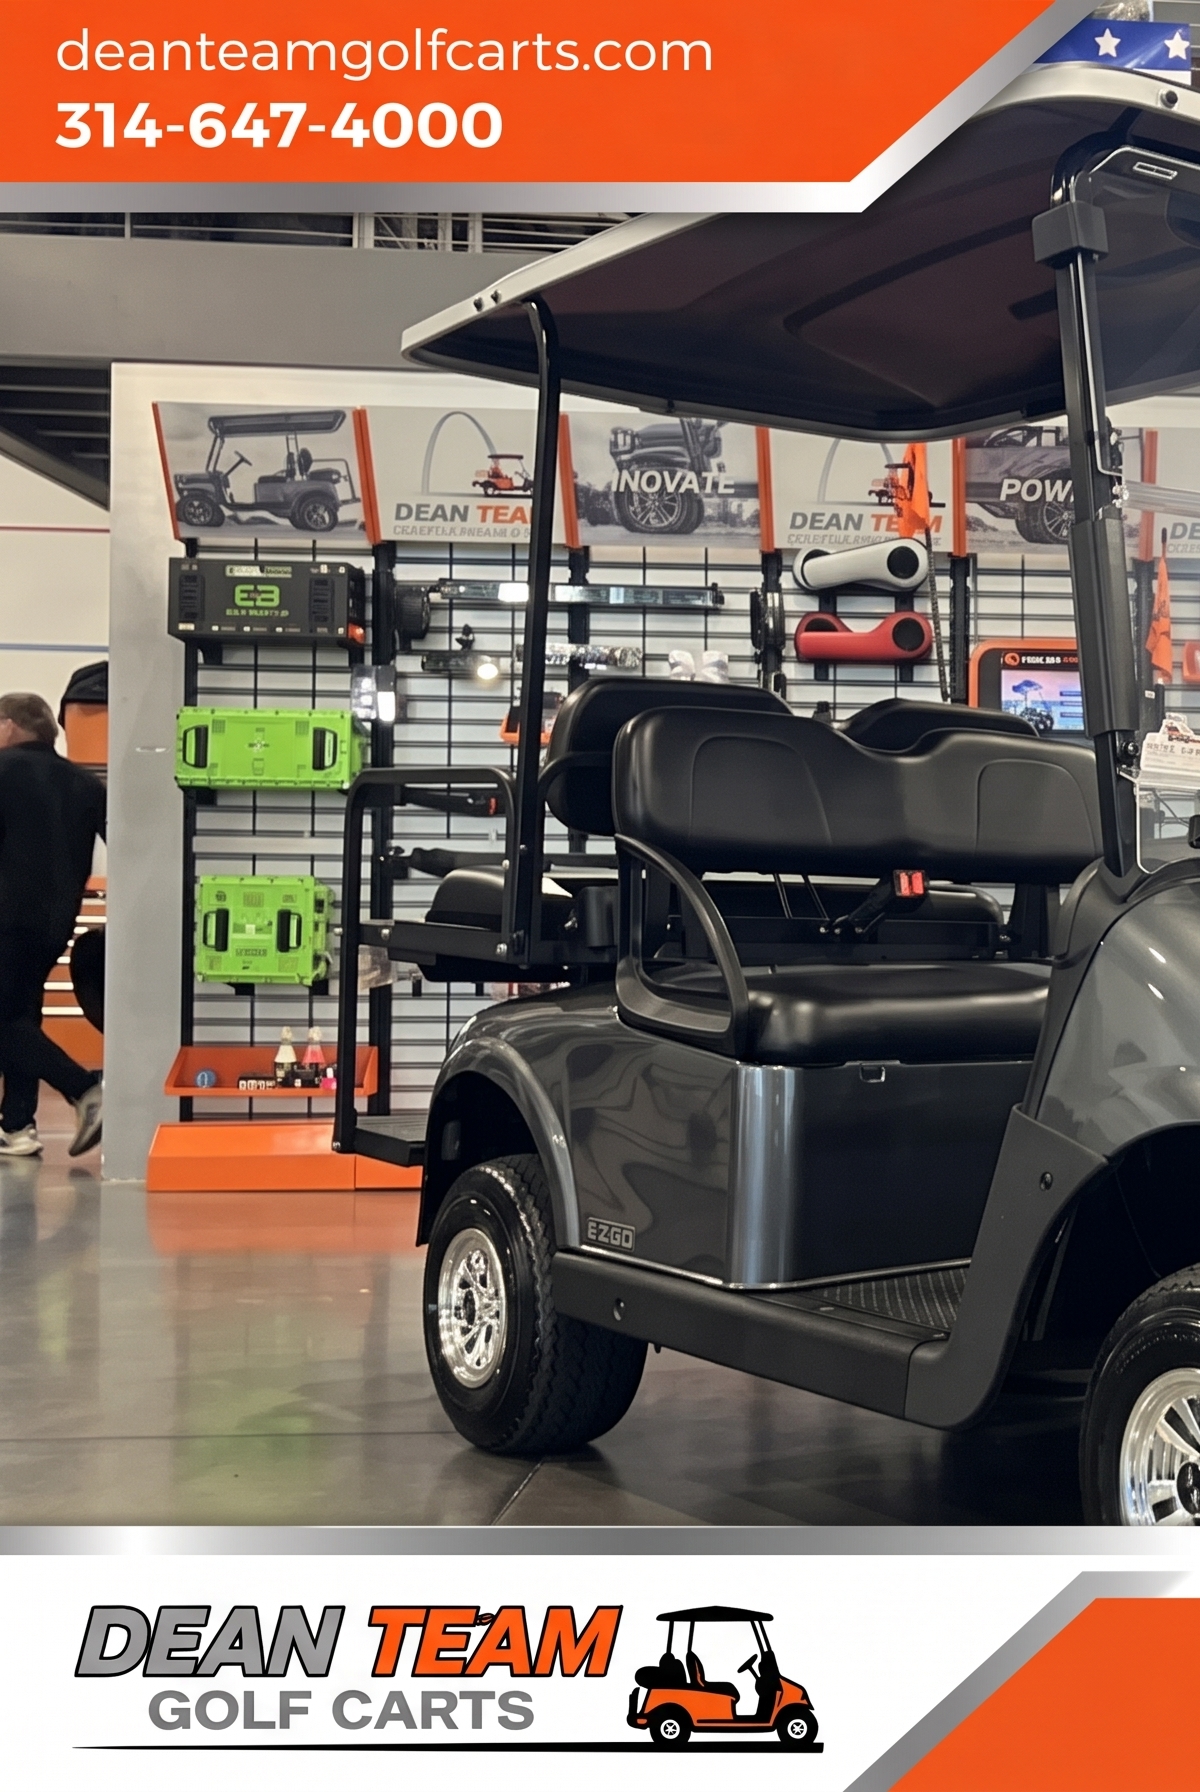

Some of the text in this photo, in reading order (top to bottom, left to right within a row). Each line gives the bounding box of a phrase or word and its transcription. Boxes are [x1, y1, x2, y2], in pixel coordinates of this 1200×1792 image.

[611, 469, 736, 494] INOVATE
[1000, 478, 1074, 502] POW
[395, 503, 532, 524] DEAN TEA
[790, 512, 943, 533] DEAN TEM
